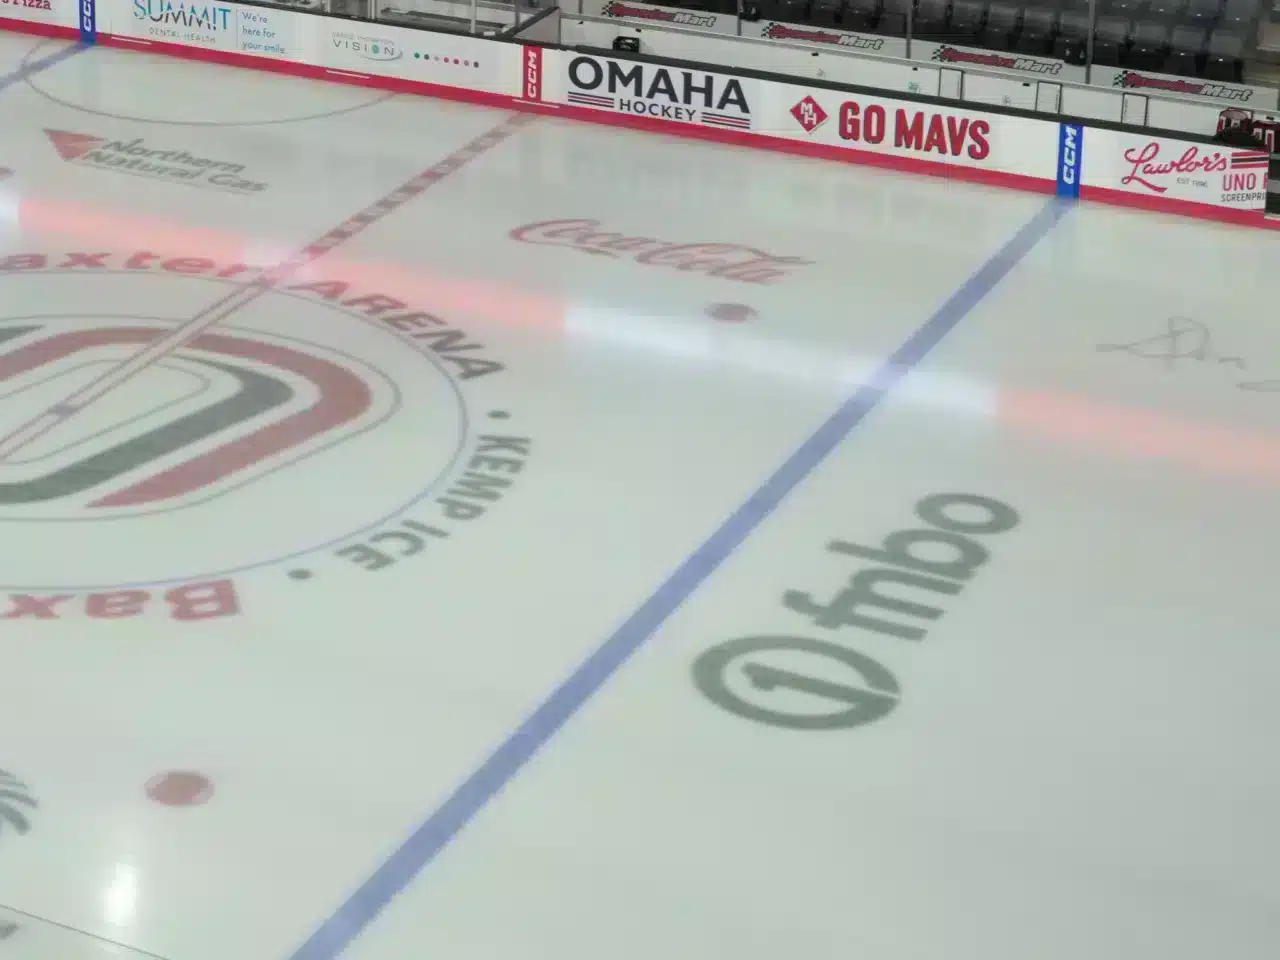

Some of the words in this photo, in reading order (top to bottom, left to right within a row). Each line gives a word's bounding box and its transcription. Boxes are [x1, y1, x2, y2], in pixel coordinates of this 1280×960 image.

[242, 11, 268, 24] We're
[242, 26, 261, 37] here
[263, 29, 276, 38] for
[242, 41, 262, 51] your
[332, 39, 396, 56] VISION
[527, 50, 538, 98] CCM
[1014, 57, 1063, 76] Mart
[567, 55, 752, 115] OMAHA
[1201, 83, 1253, 102] Mart
[619, 99, 697, 122] HOCKEY
[838, 100, 887, 144] GO
[894, 107, 991, 161] MAVS
[1062, 125, 1078, 185] CCM
[1121, 142, 1228, 193] Lawlor's
[1222, 172, 1257, 192] UNO
[287, 278, 506, 382] ARENA
[435, 434, 533, 521] KEMP
[332, 519, 451, 571] ICE
